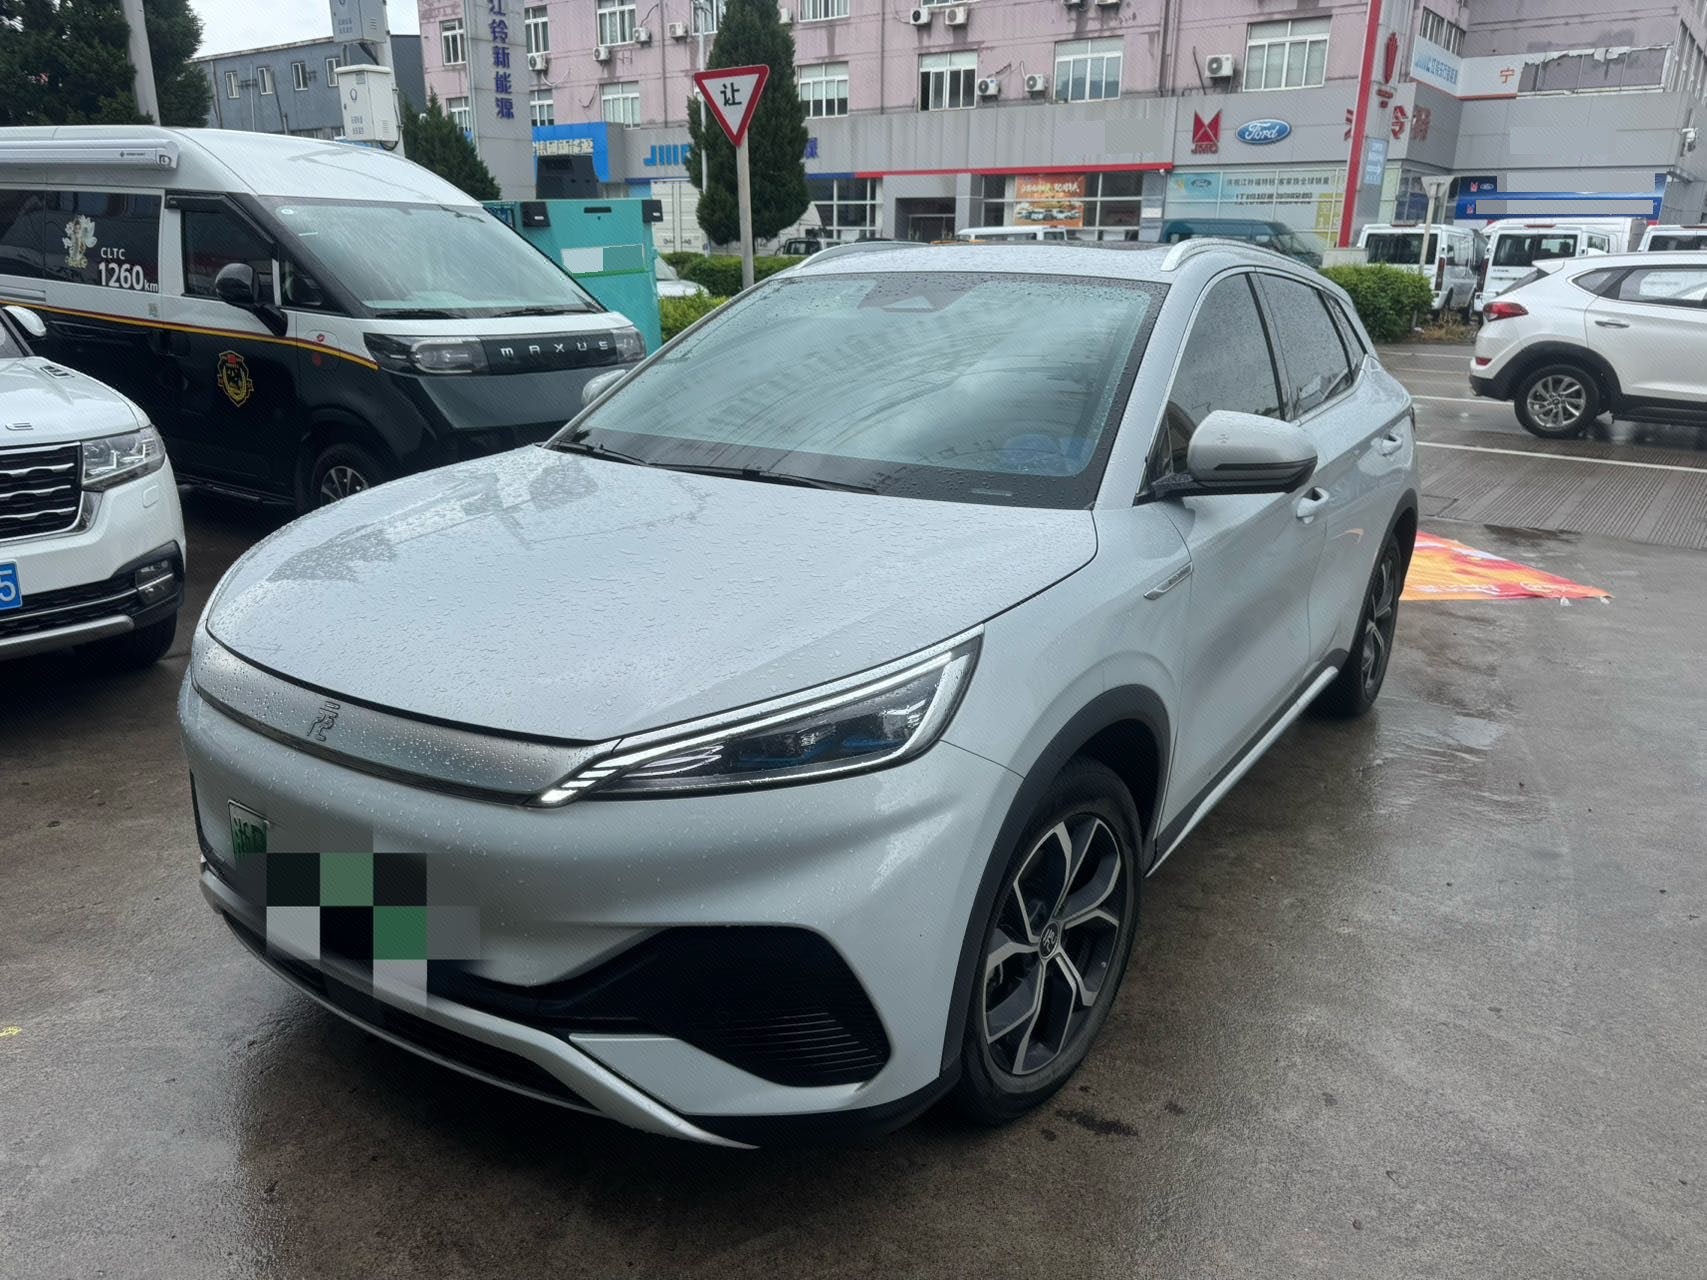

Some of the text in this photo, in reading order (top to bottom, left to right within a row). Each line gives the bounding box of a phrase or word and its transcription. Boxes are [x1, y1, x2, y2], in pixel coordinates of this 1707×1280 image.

[488, 0, 515, 119] 江铃新能源
[720, 82, 742, 107] 让
[100, 247, 126, 260] CLTC
[99, 262, 159, 292] 1260 km
[500, 341, 609, 357] MAXUS
[0, 569, 17, 600] 5
